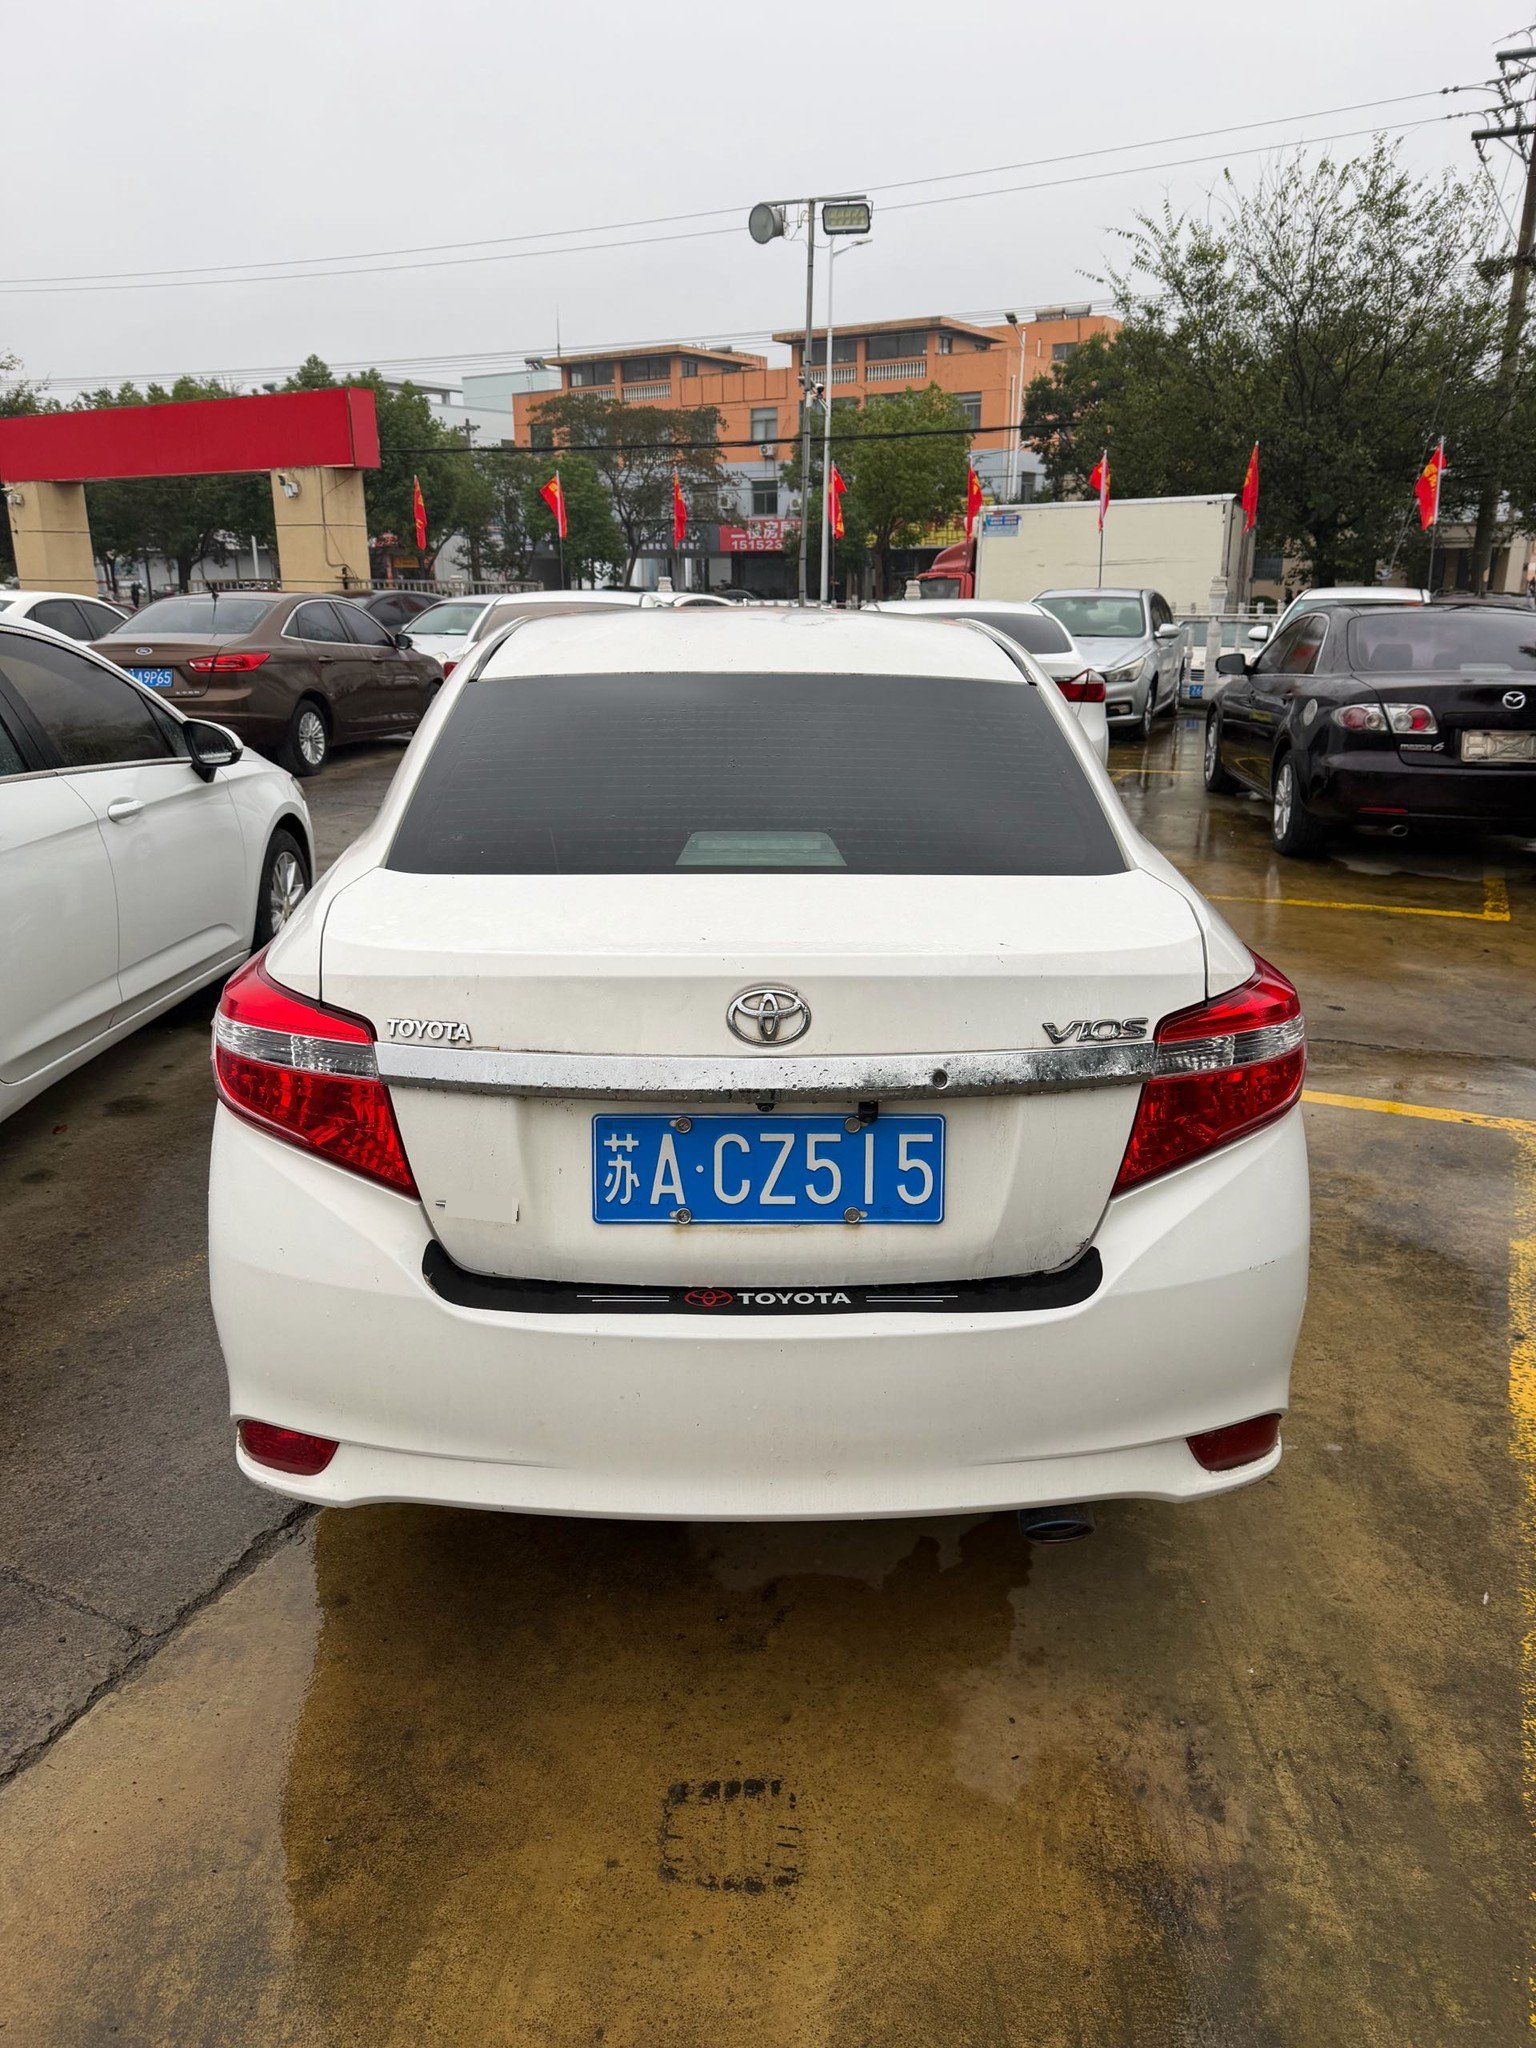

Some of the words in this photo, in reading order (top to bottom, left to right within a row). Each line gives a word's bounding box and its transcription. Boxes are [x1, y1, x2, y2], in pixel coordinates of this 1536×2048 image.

[386, 1018, 471, 1042] TOYOTA
[1042, 1018, 1149, 1044] VIOS
[737, 1292, 851, 1305] TOYOTA
